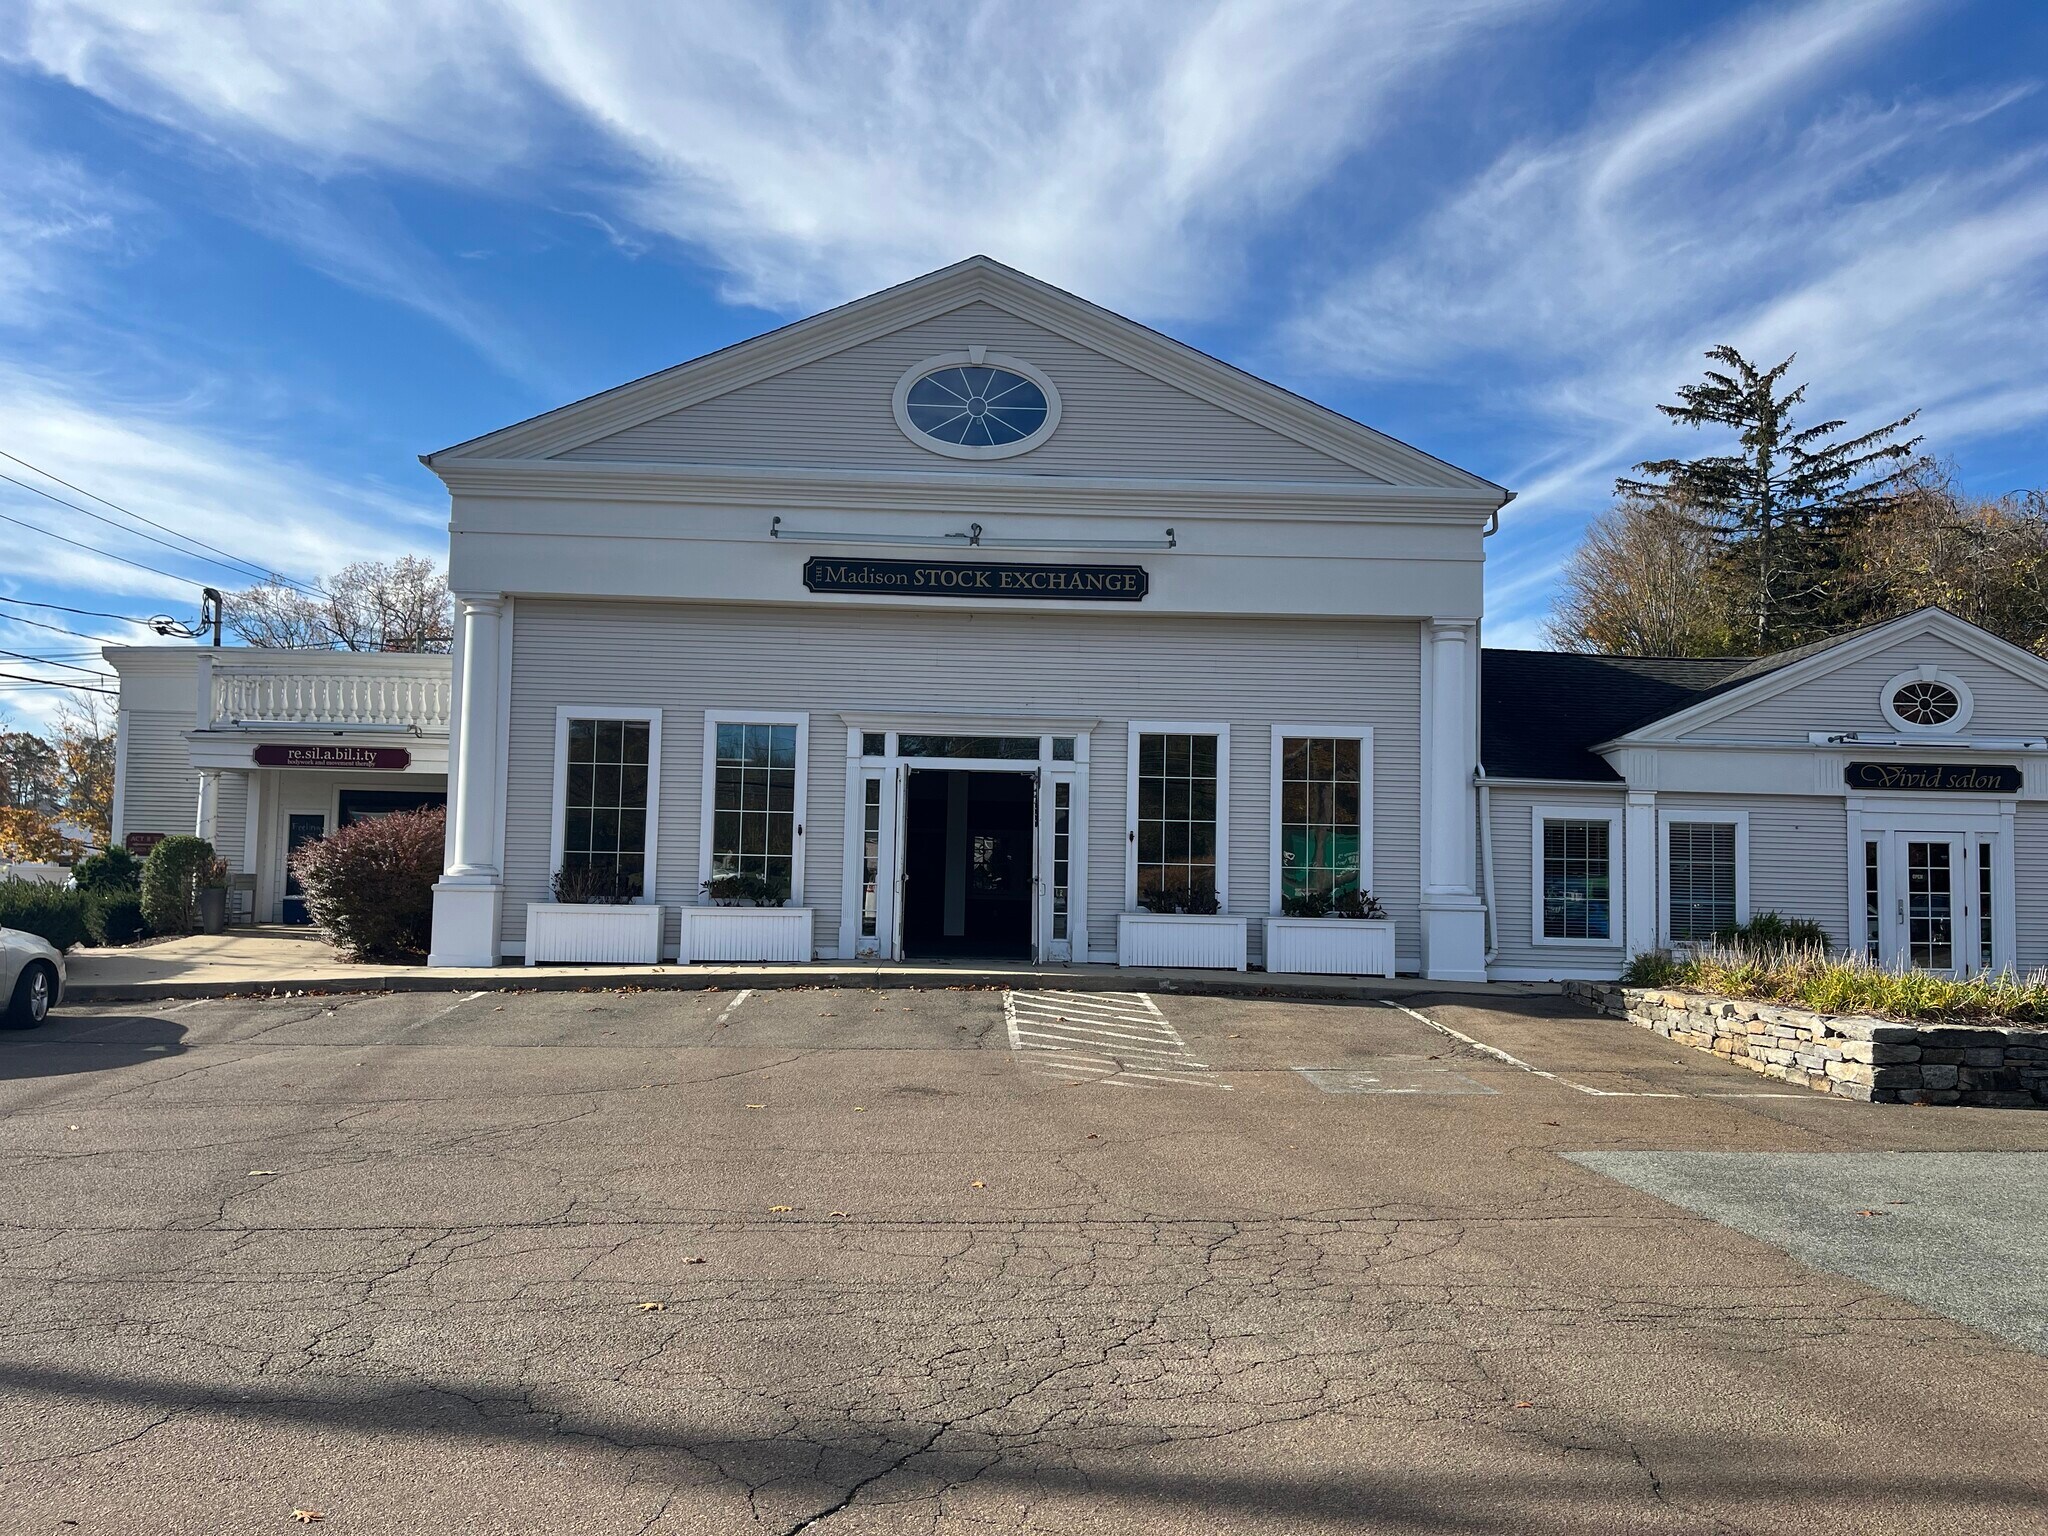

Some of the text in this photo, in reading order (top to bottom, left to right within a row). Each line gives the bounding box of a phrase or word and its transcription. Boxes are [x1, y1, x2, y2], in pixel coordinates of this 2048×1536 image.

[825, 566, 1138, 591] Madison STOCK EXCHANGE
[288, 747, 377, 763] re.sil.a.bil.i.ty
[1861, 764, 2002, 789] Vivid salon
